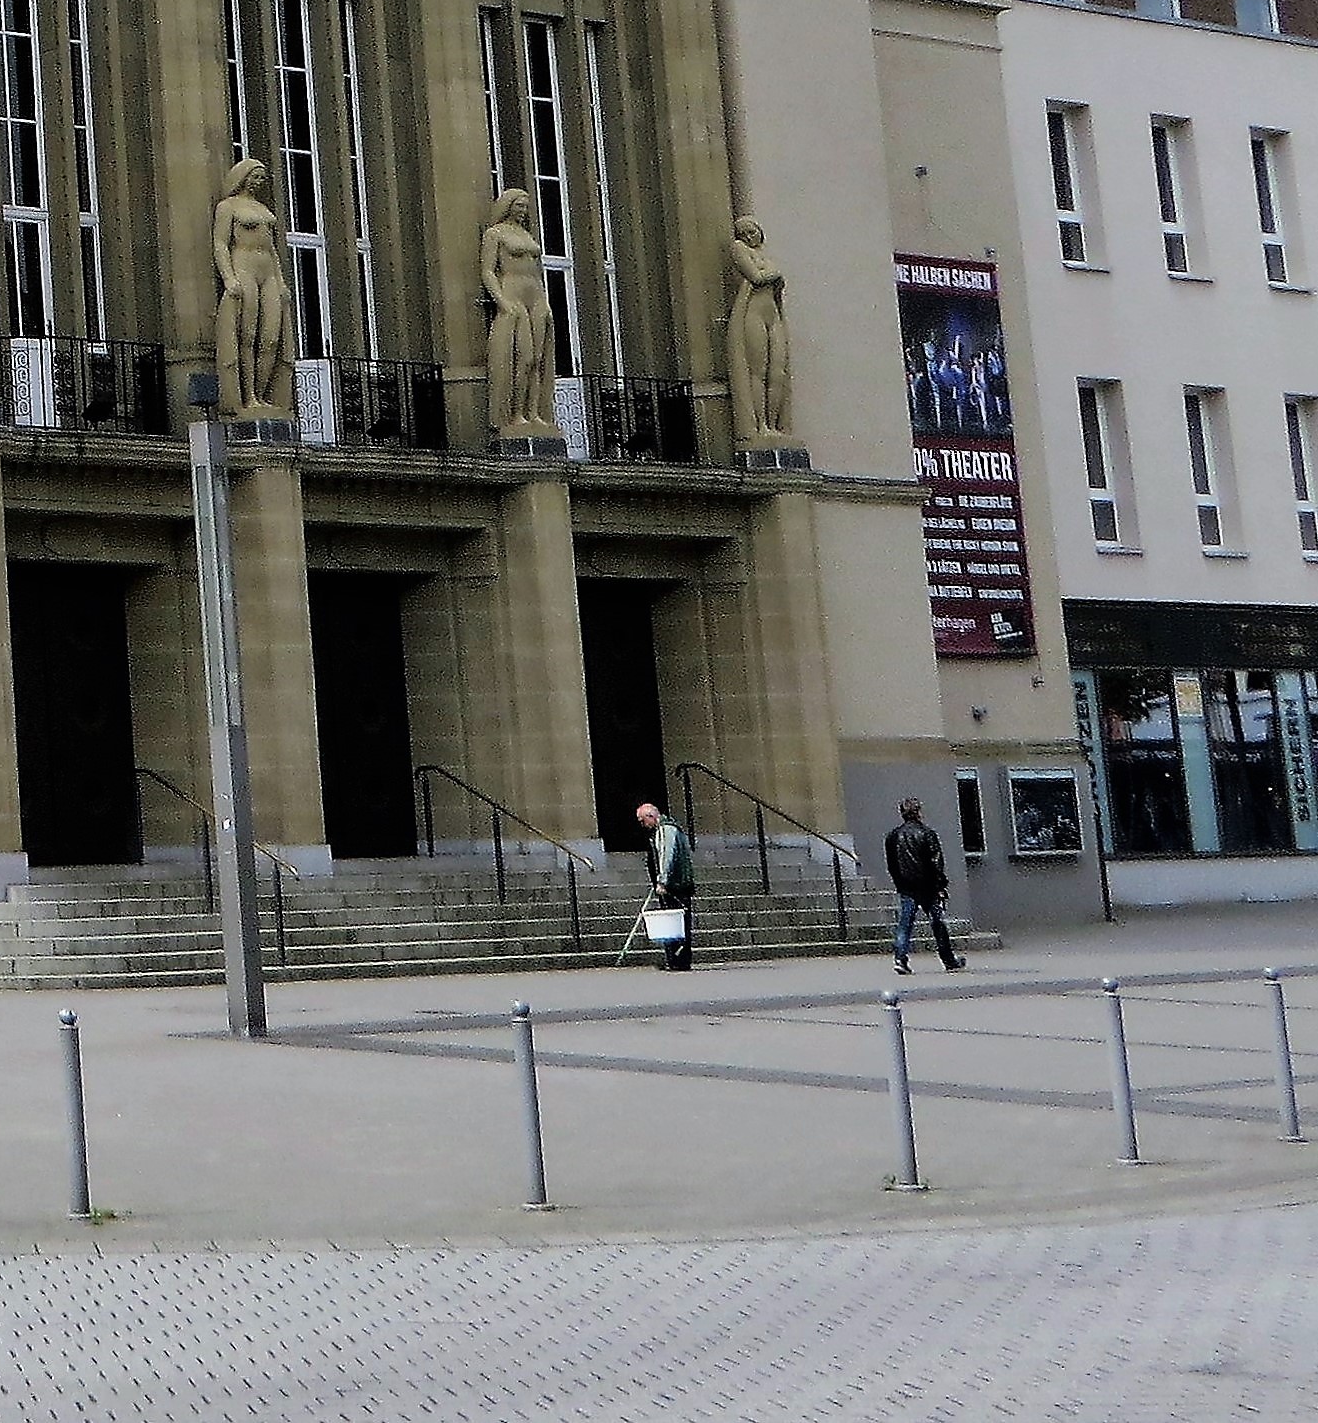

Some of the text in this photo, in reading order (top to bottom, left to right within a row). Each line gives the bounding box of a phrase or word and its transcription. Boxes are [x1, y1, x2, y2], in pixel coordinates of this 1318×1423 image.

[911, 265, 951, 286] HALBEN
[952, 268, 991, 290] SACHEN
[940, 449, 1013, 480] THEATER
